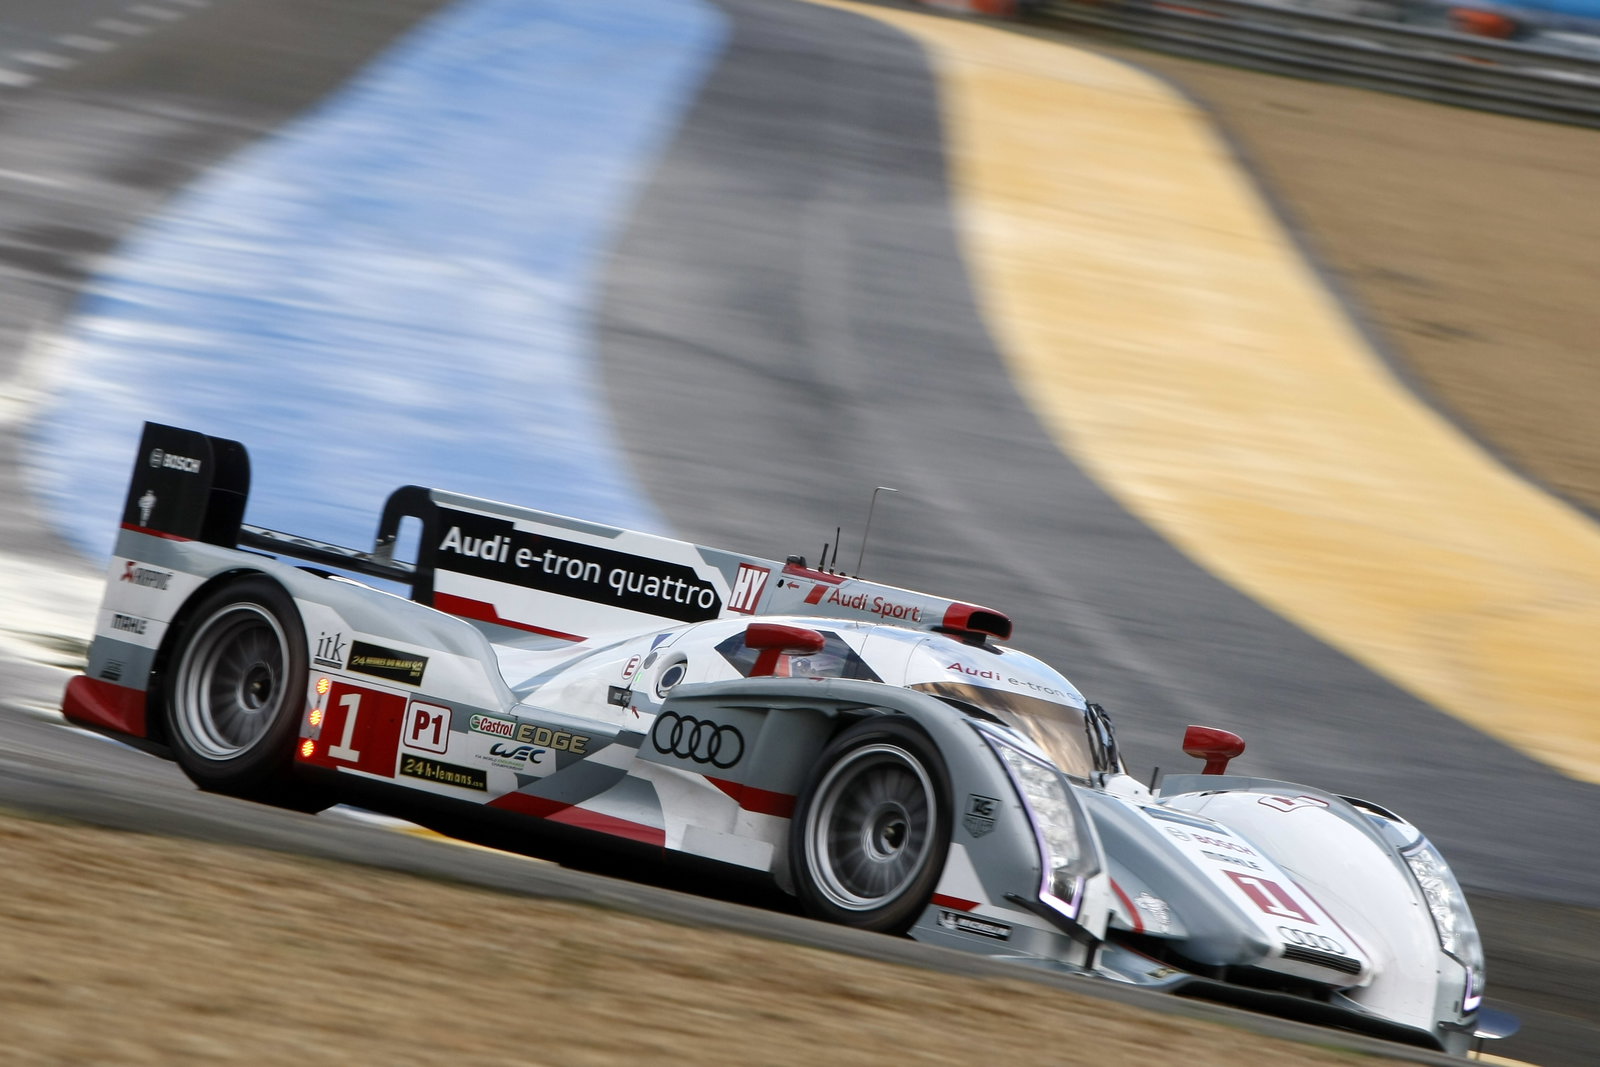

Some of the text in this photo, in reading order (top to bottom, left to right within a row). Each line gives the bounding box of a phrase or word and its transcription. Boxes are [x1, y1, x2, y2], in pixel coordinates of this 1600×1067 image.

[439, 526, 715, 609] Audi e-tron quattro
[730, 567, 769, 610] HY
[827, 590, 921, 621] Audi Sport
[315, 631, 347, 662] itk
[351, 655, 365, 666] 24
[623, 658, 639, 676] E
[946, 662, 1001, 680] Audi
[1007, 677, 1064, 697] e-tron
[328, 693, 362, 763] 1
[412, 709, 443, 745] P1
[480, 717, 591, 755] Castrol EDGE
[489, 742, 546, 764] WEC
[1237, 876, 1305, 920] 1
